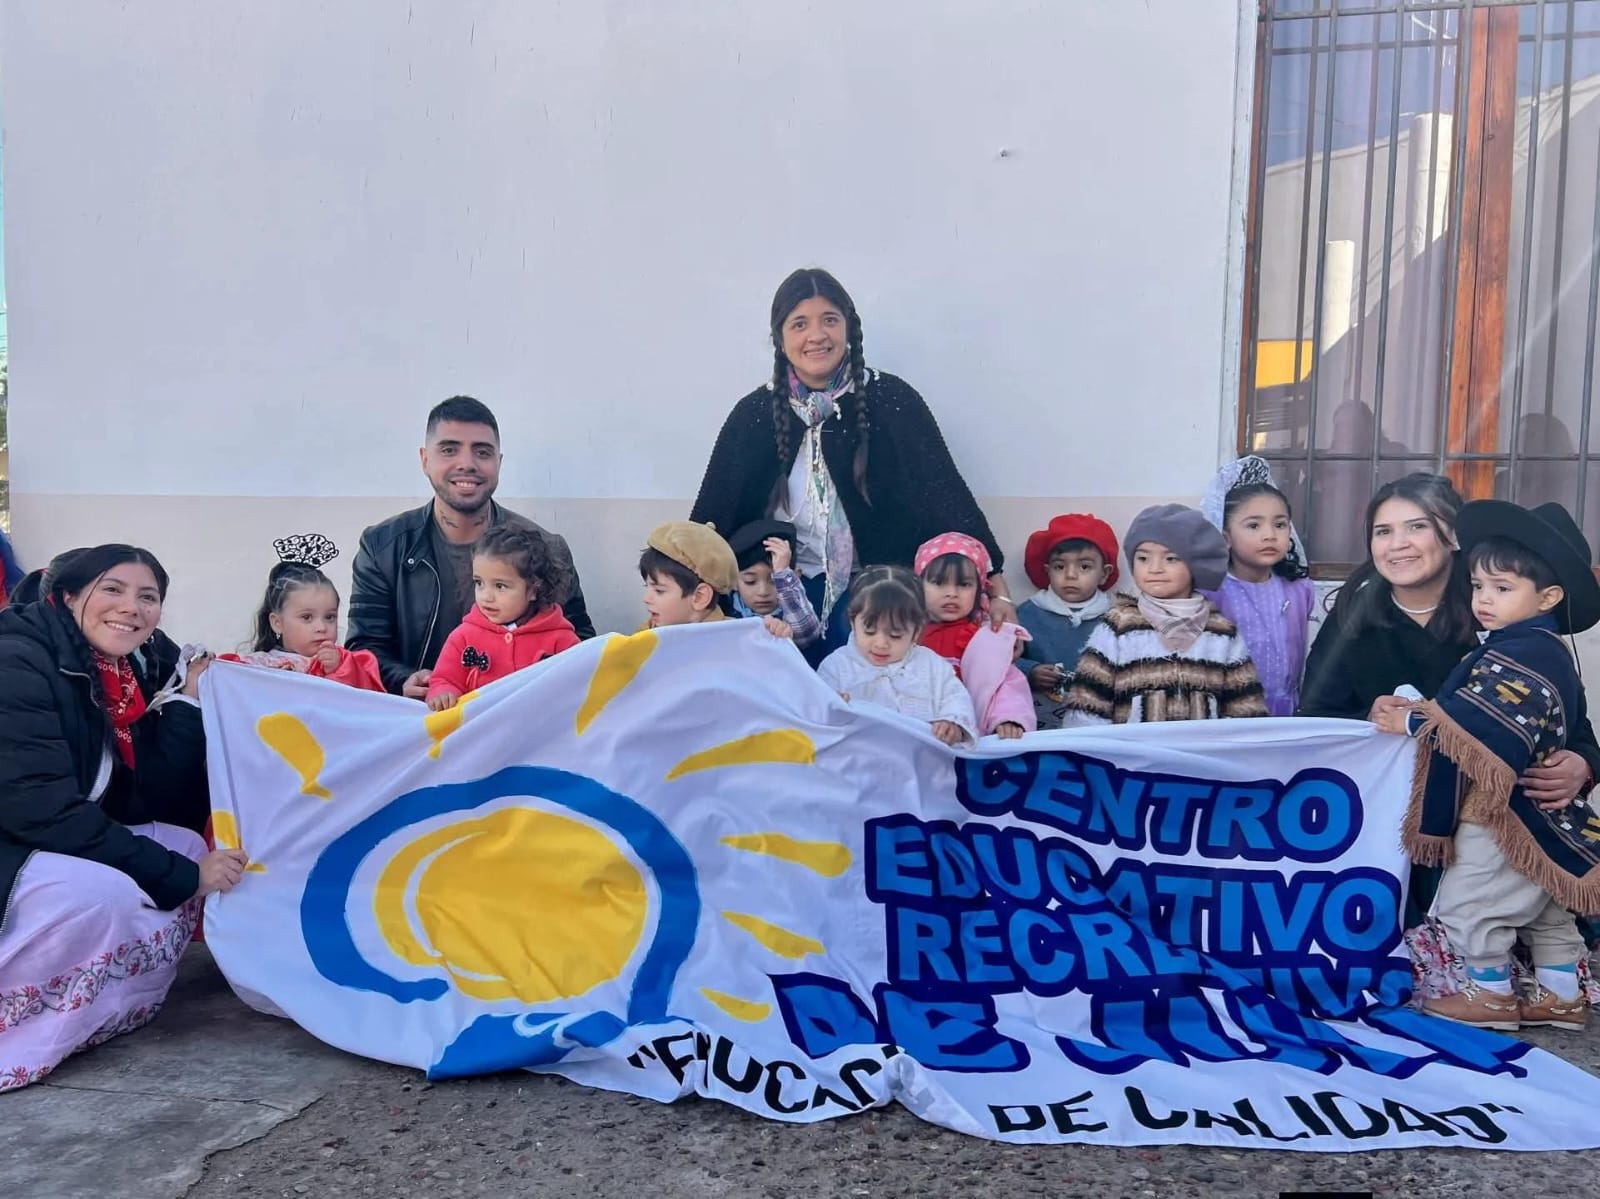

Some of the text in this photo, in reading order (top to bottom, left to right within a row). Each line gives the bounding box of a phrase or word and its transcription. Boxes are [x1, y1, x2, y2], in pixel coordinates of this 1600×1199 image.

[957, 752, 1361, 860] CENTRO
[866, 816, 1401, 955] EDUCATIVO
[889, 905, 1412, 1020] RECREIVO
[988, 1091, 1107, 1133] DE
